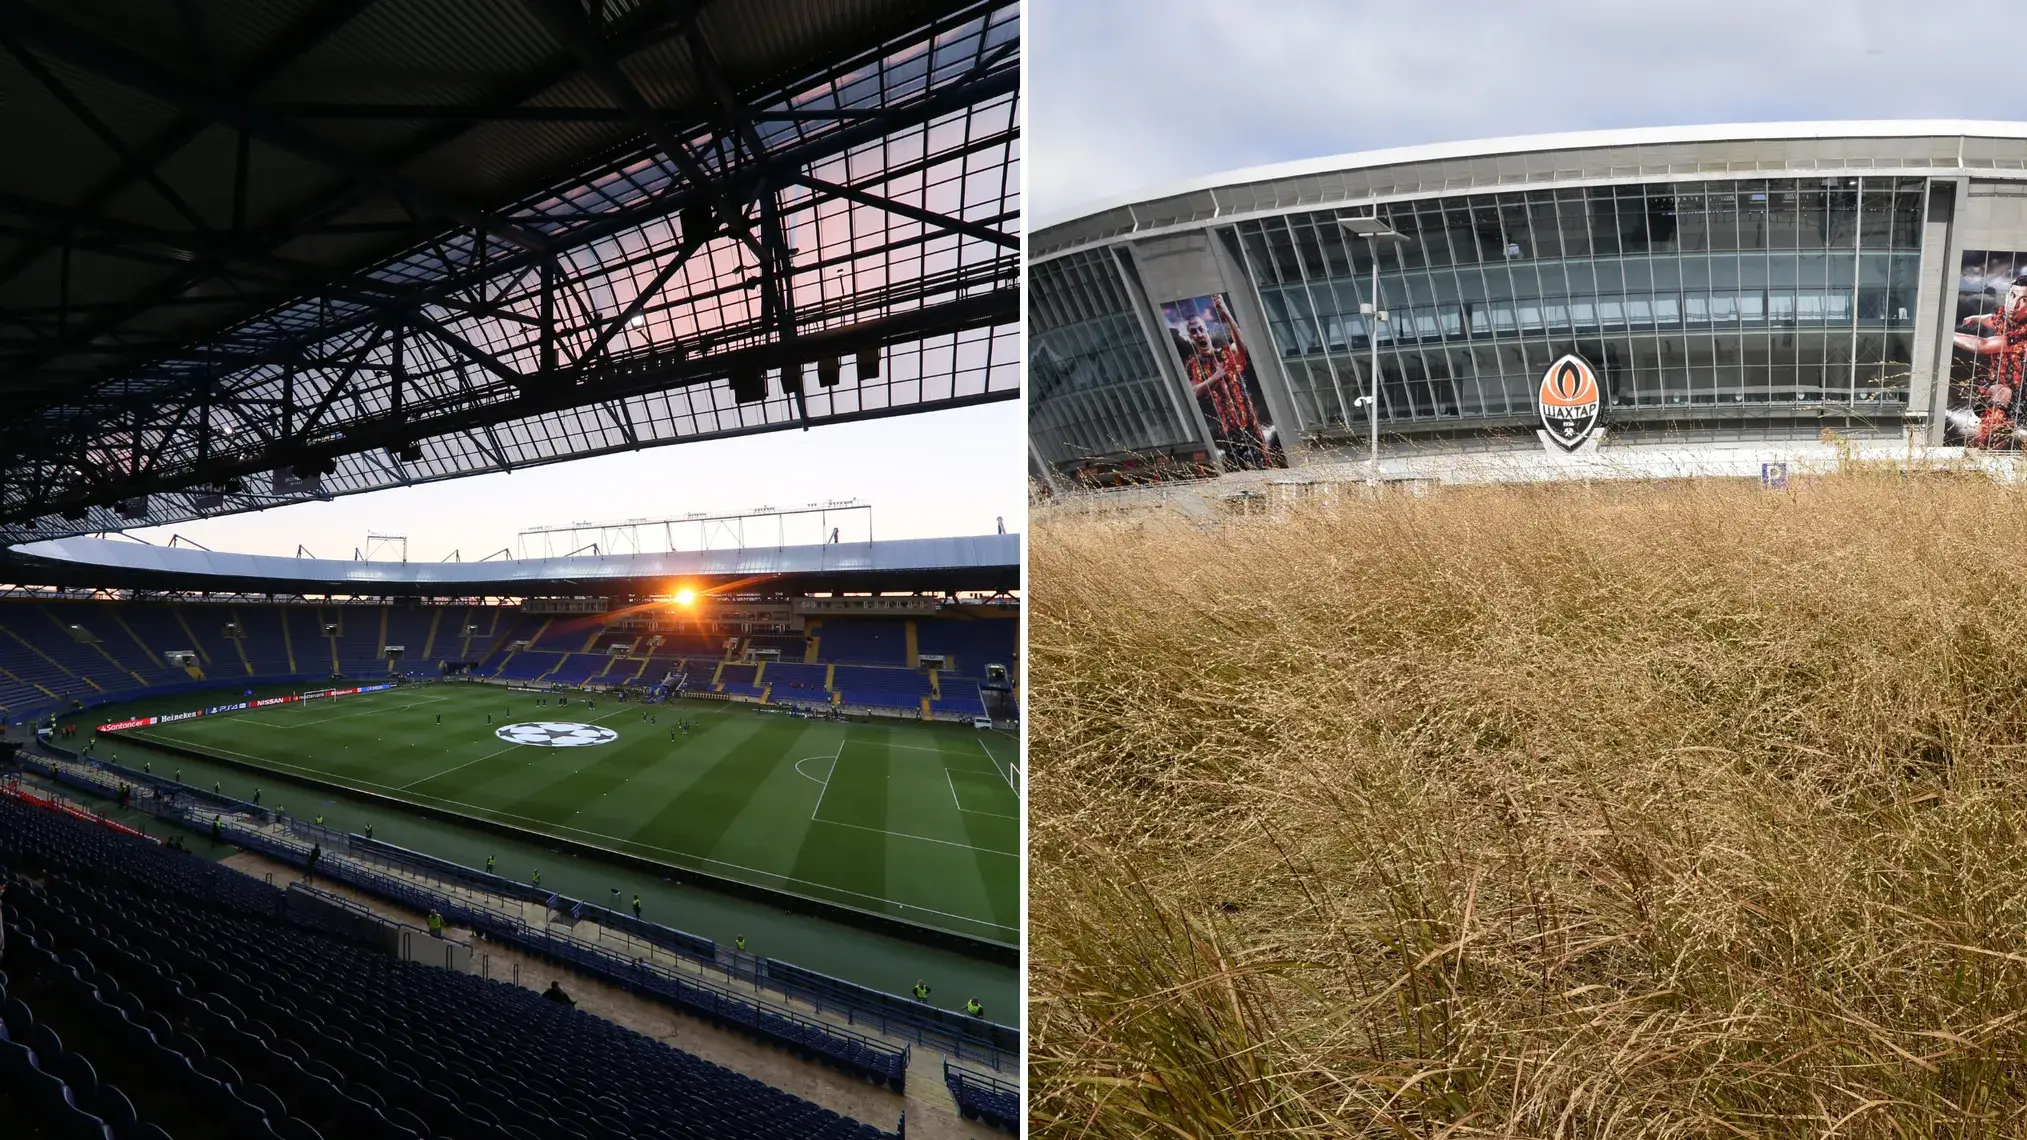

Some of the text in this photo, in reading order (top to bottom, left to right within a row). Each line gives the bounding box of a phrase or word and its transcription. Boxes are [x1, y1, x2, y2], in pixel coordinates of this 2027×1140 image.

[1543, 403, 1596, 418] ШАХТАР
[257, 697, 284, 707] NISSAN
[161, 711, 197, 723] Heineken
